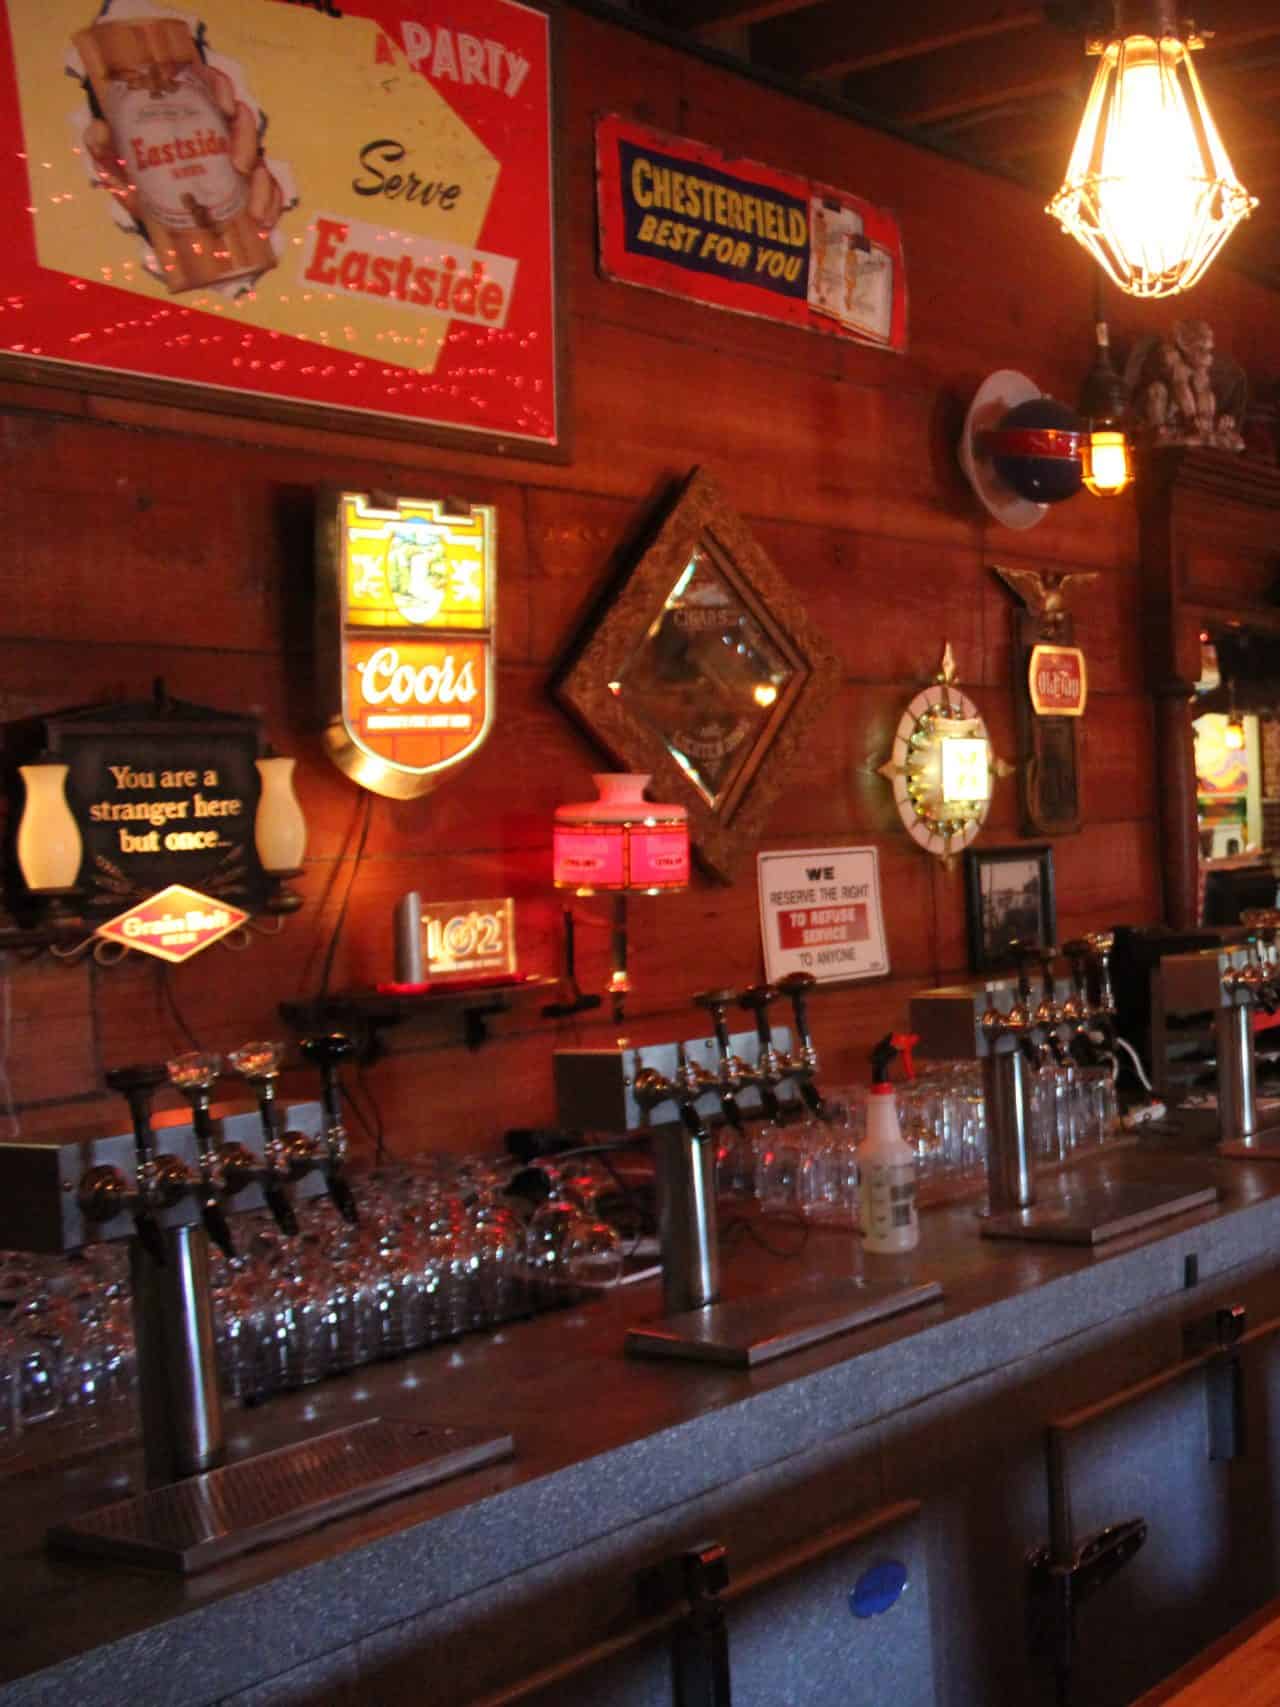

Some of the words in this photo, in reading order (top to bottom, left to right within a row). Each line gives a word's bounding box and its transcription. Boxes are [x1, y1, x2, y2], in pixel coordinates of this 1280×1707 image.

[400, 20, 530, 99] PARTY
[352, 139, 462, 210] Serve
[631, 157, 808, 247] CHESTERFIELD
[638, 214, 700, 253] BEST
[700, 231, 752, 269] FOR
[755, 245, 802, 282] YOU
[304, 218, 505, 321] Eastside
[356, 646, 477, 704] Coors
[109, 765, 155, 789] You
[160, 769, 196, 788] are
[203, 770, 218, 787] a
[89, 800, 189, 825] stranger
[193, 793, 242, 818] here
[119, 829, 160, 853] but
[805, 867, 835, 881] WE
[769, 888, 816, 905] RESERVE
[819, 886, 838, 902] THE
[841, 883, 869, 900] RIGHT
[789, 911, 807, 928] TO
[810, 907, 857, 925] REFUSE
[799, 951, 814, 967] TO
[817, 947, 857, 965] ANYONE
